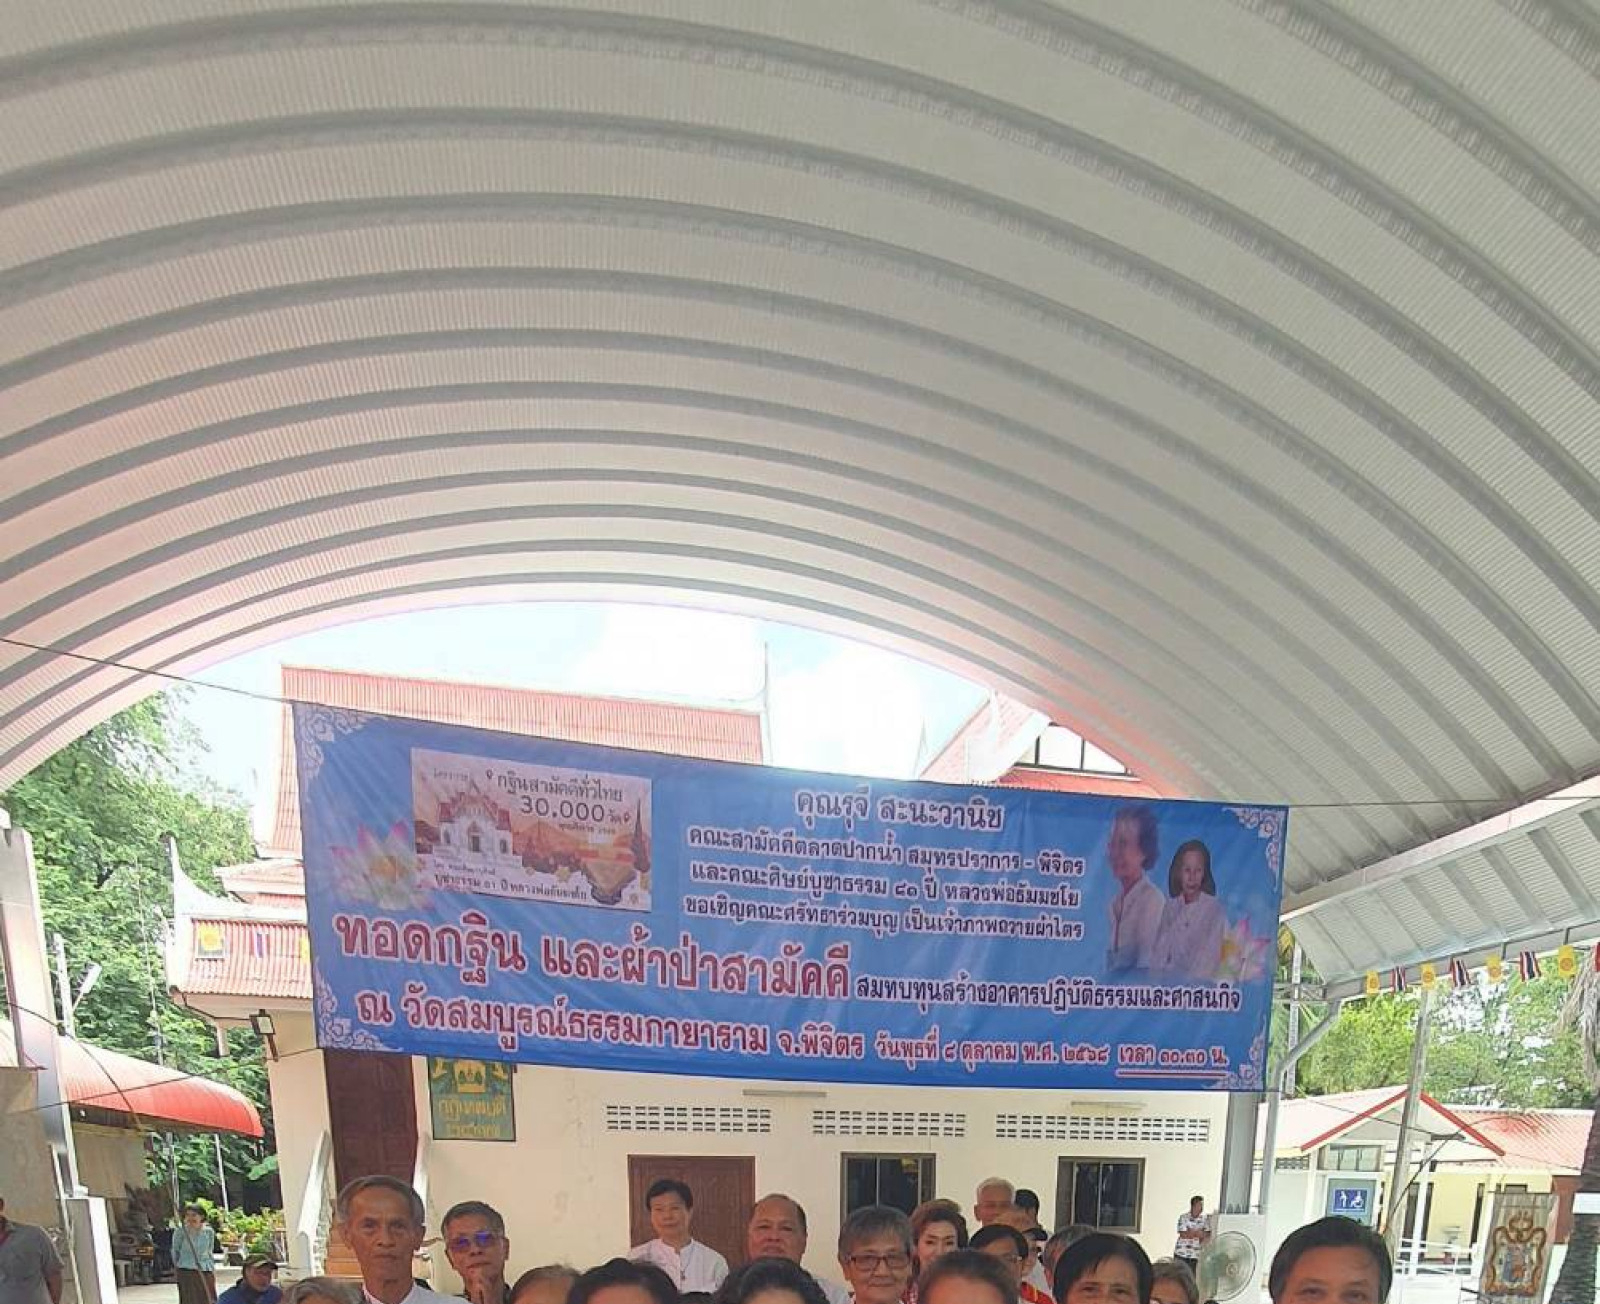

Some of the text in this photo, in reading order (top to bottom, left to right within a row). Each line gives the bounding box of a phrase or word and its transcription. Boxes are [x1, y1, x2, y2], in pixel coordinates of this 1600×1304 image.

[797, 786, 870, 829] คุณรุจี
[689, 828, 901, 862] คณะสามัคคีตลาดปากน้ำ
[908, 848, 1019, 874] สมุทรปราการ
[1039, 851, 1083, 875] พิจิตร
[692, 863, 887, 898] และคณะศิษย์บูชาธรรม
[924, 876, 937, 898] ปี
[945, 879, 1079, 906] หลวงพ่อธัมมชโย
[686, 893, 1083, 938] ขอเชิญคณะศรัทธาร่วมบุญ เป็นเจ้าภาพถวายผ้าไตร
[334, 911, 1240, 1012] ทอดกฐิน และผ้าป่าสามัคคี สมทบทุนสร้างอาคารปฏิบัติธรรมและศาสนกิจ
[357, 993, 393, 1023] ณ
[403, 983, 767, 1051] วัดสมบูรณ์ธรรมกายาราม
[778, 1023, 864, 1057] จ.พิจิตร
[876, 1027, 940, 1069] วันพุธที่
[961, 1043, 1017, 1071] ตุลาคม
[1023, 1043, 1057, 1062] พ.ศ.
[1120, 1046, 1154, 1063] เวลา
